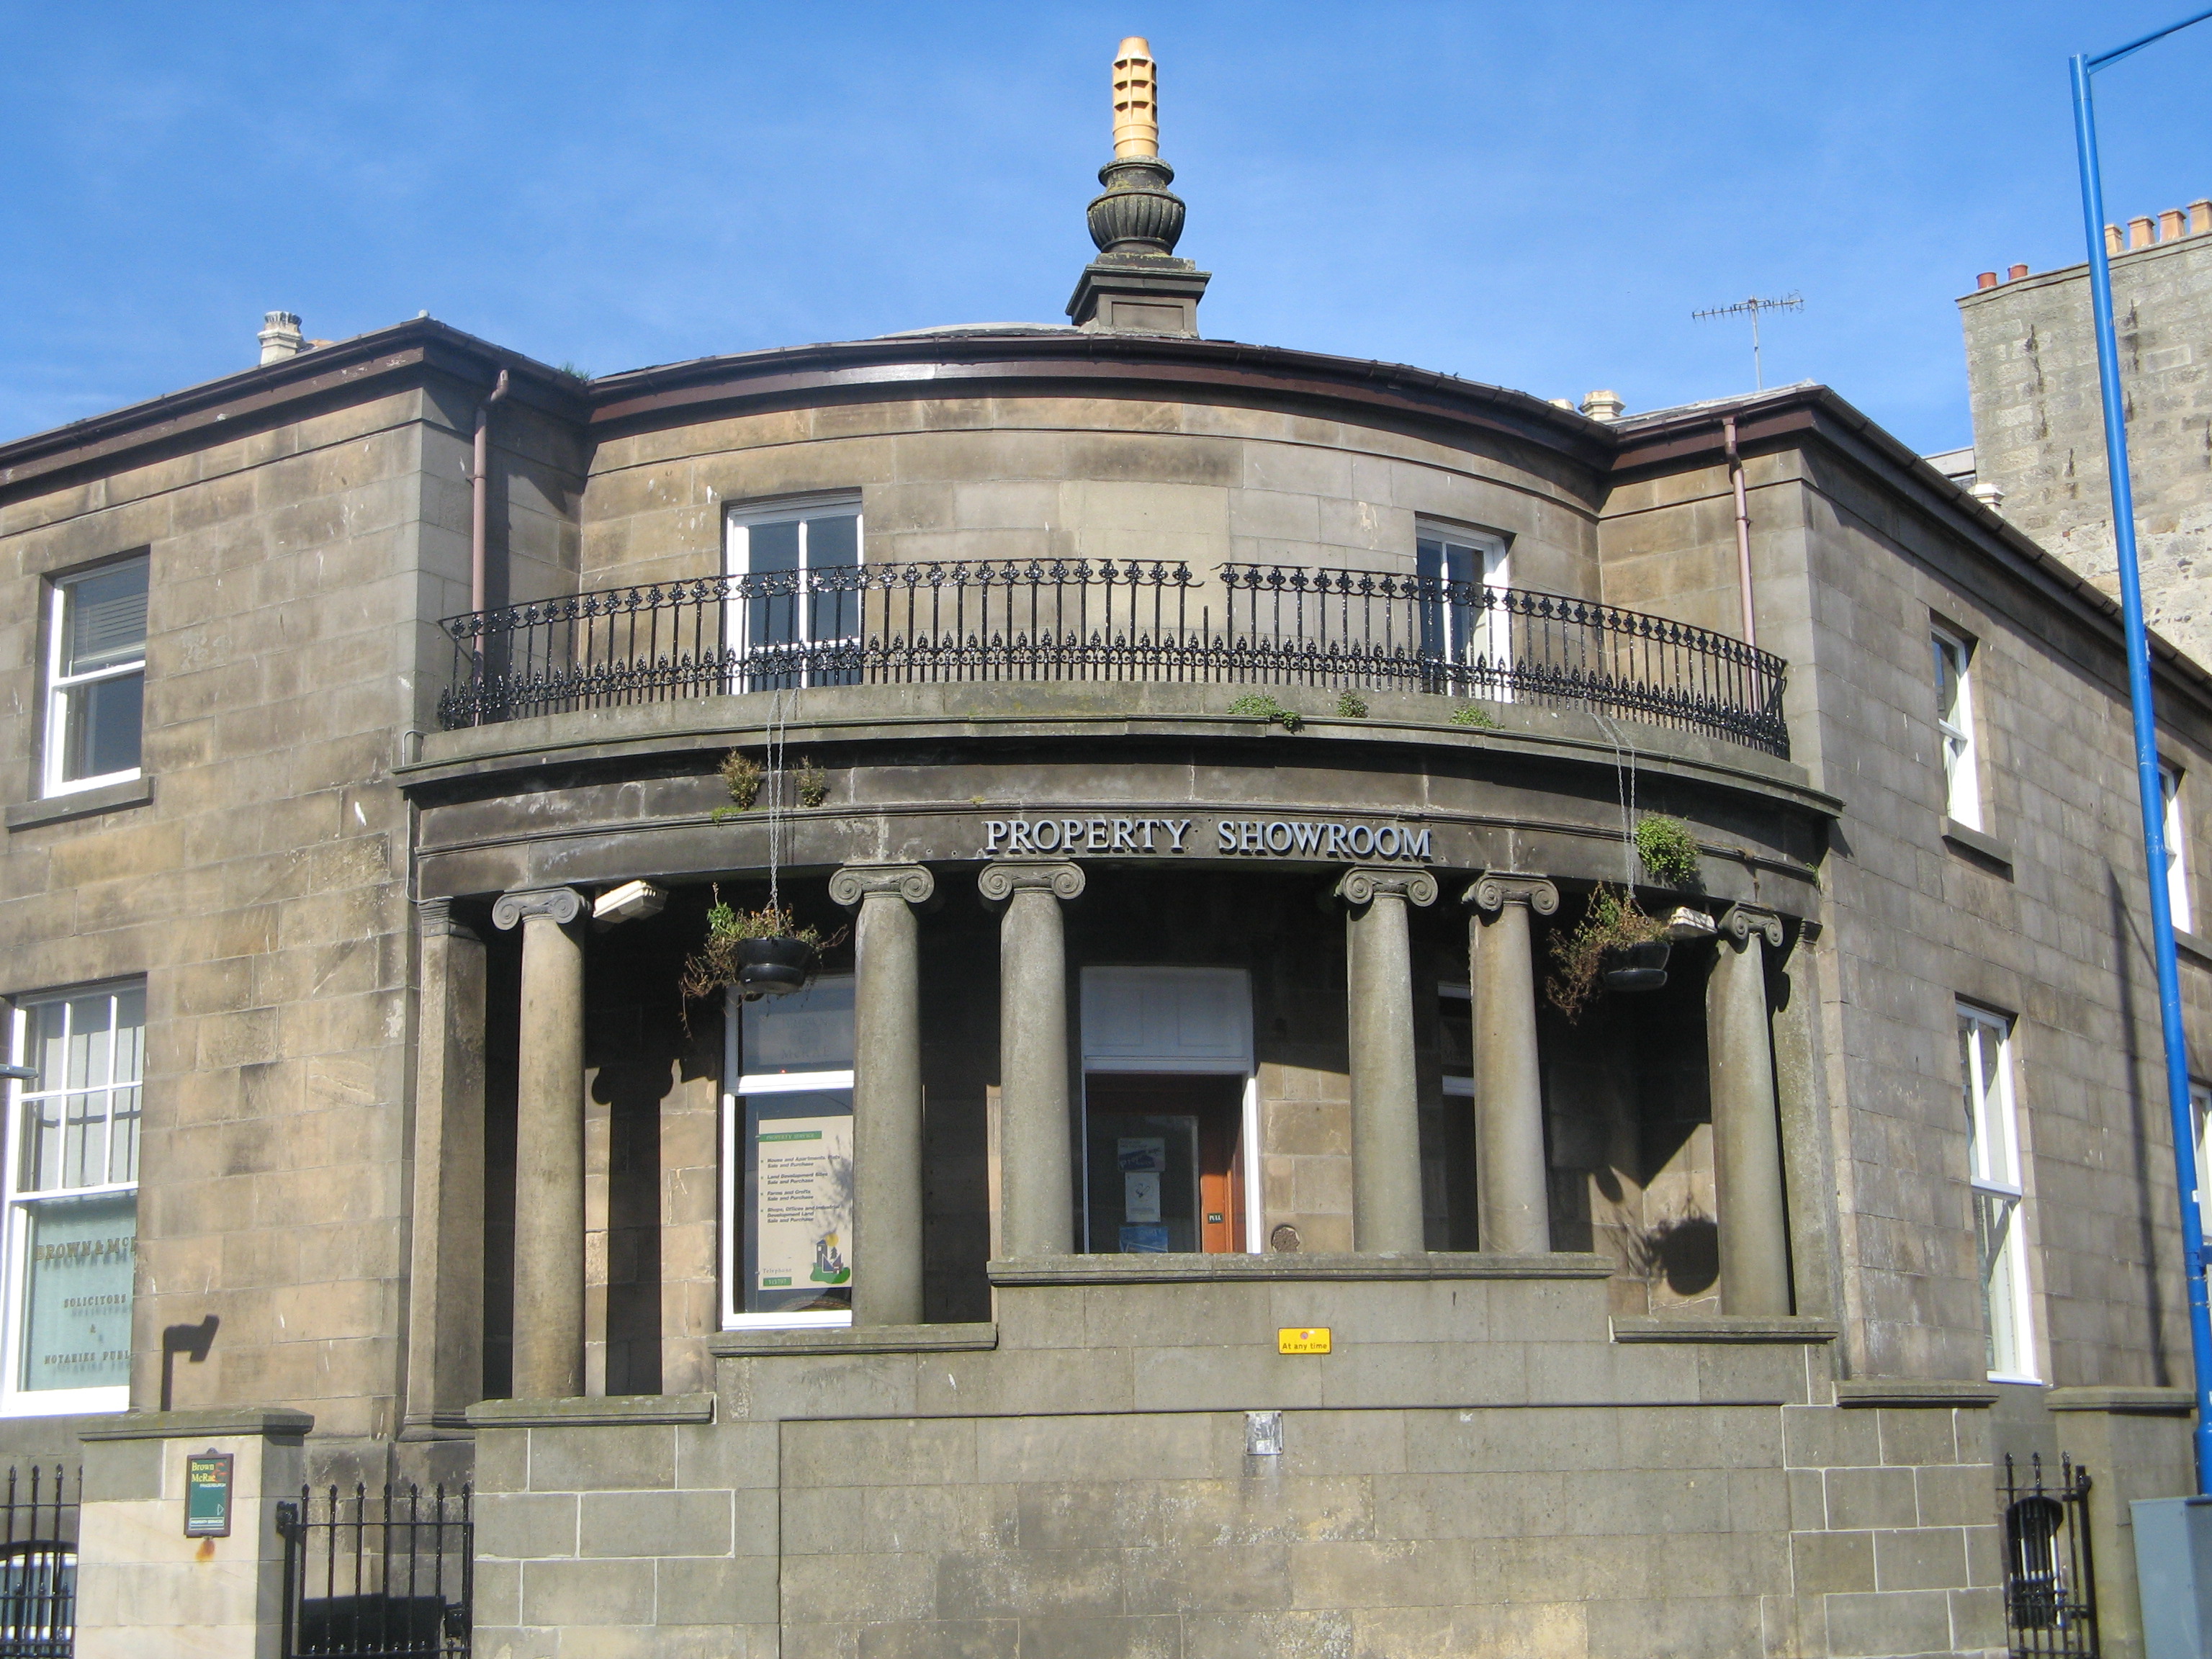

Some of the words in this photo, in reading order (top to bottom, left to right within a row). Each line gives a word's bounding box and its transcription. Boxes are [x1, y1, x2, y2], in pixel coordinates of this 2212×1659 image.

[984, 818, 1191, 850] PROPERTY
[1217, 819, 1431, 858] SHOWROOM
[36, 1241, 92, 1260] BROWN
[94, 1239, 104, 1255] &
[63, 1293, 127, 1308] SOLICITORS
[44, 1352, 96, 1364] NOTARIES
[192, 1462, 215, 1471] Brown
[192, 1473, 217, 1483] McRae
